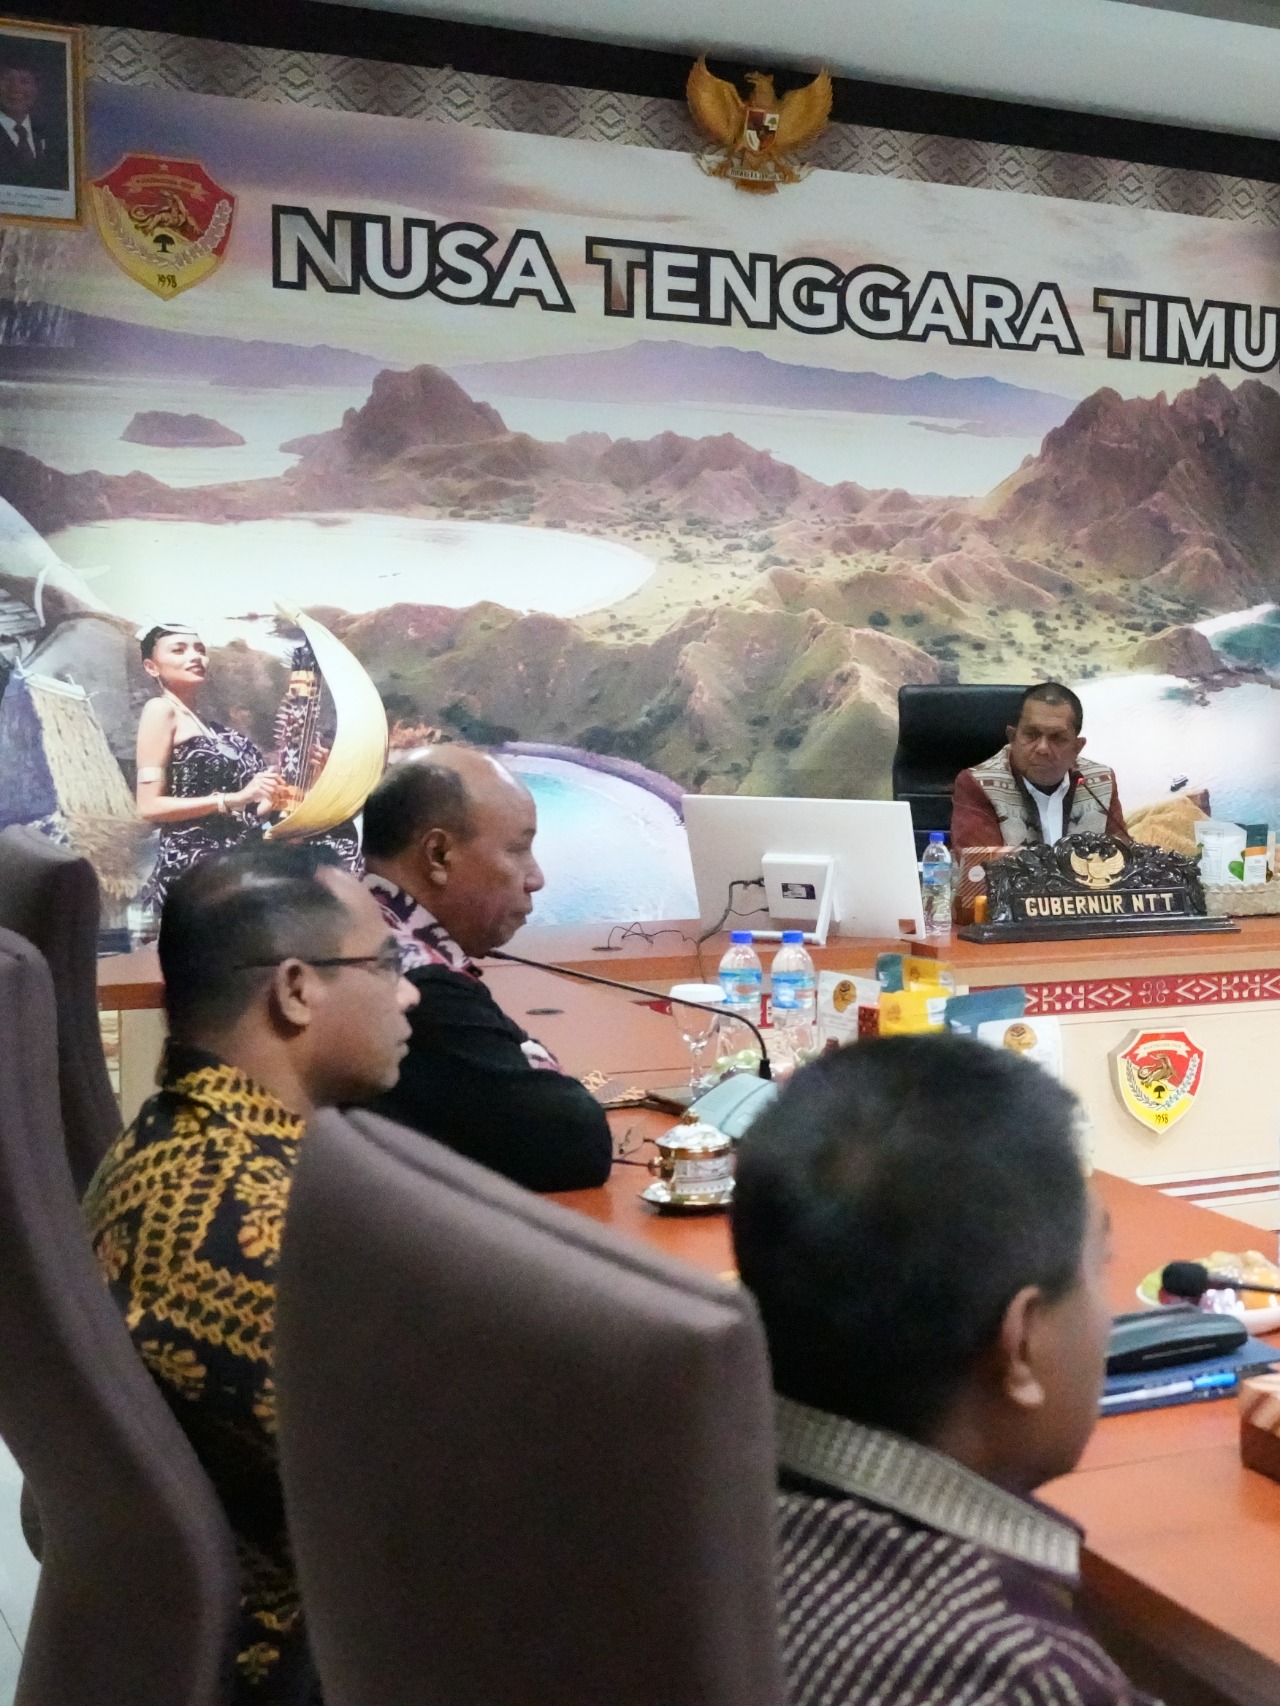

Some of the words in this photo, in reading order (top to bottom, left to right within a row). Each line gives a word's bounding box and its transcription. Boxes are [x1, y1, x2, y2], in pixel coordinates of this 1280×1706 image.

[272, 204, 576, 313] NUSA
[586, 235, 1084, 356] TENGGARA
[1024, 893, 1125, 918] GUBERNUR
[1131, 892, 1175, 913] NTT
[1155, 1113, 1169, 1124] 1958
